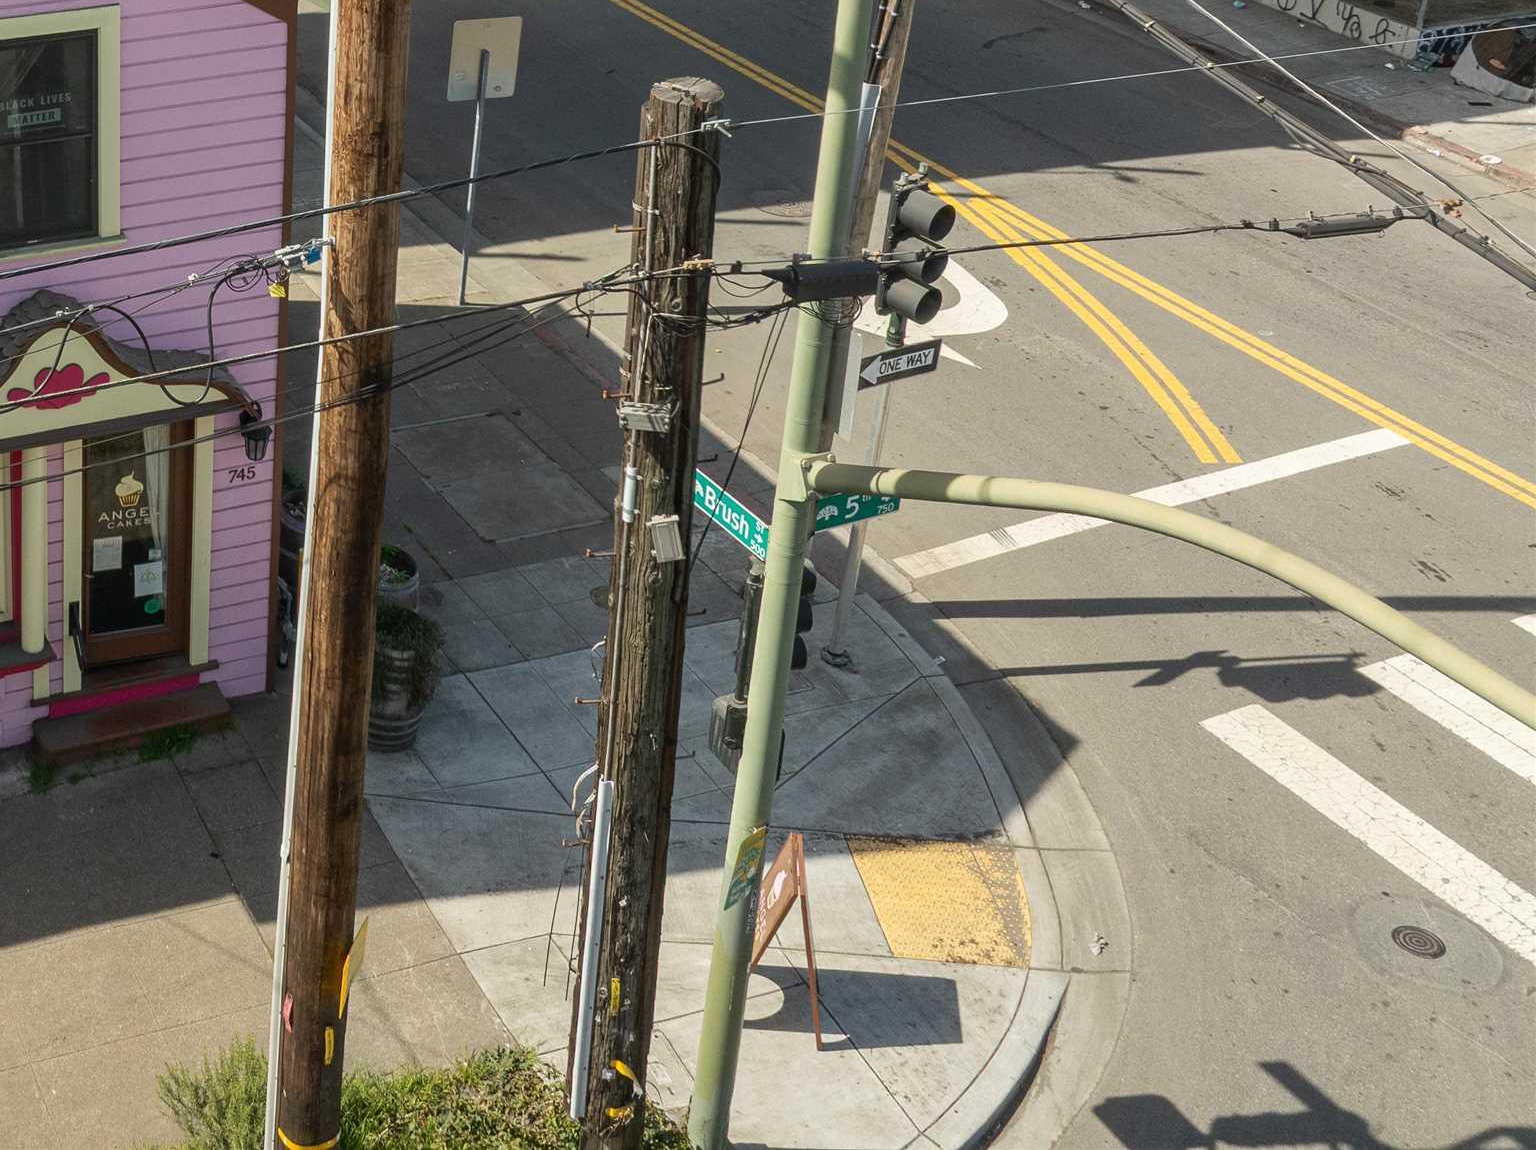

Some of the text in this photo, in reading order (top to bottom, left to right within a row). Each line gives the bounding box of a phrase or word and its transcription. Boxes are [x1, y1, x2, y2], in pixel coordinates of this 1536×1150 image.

[40, 92, 72, 106] LIVES
[879, 350, 931, 375] ONE WAY
[228, 466, 256, 484] 745
[703, 484, 750, 540] Brush
[876, 502, 895, 515] 750
[106, 519, 152, 530] CAKES
[755, 521, 767, 533] ST
[750, 539, 766, 558] 500
